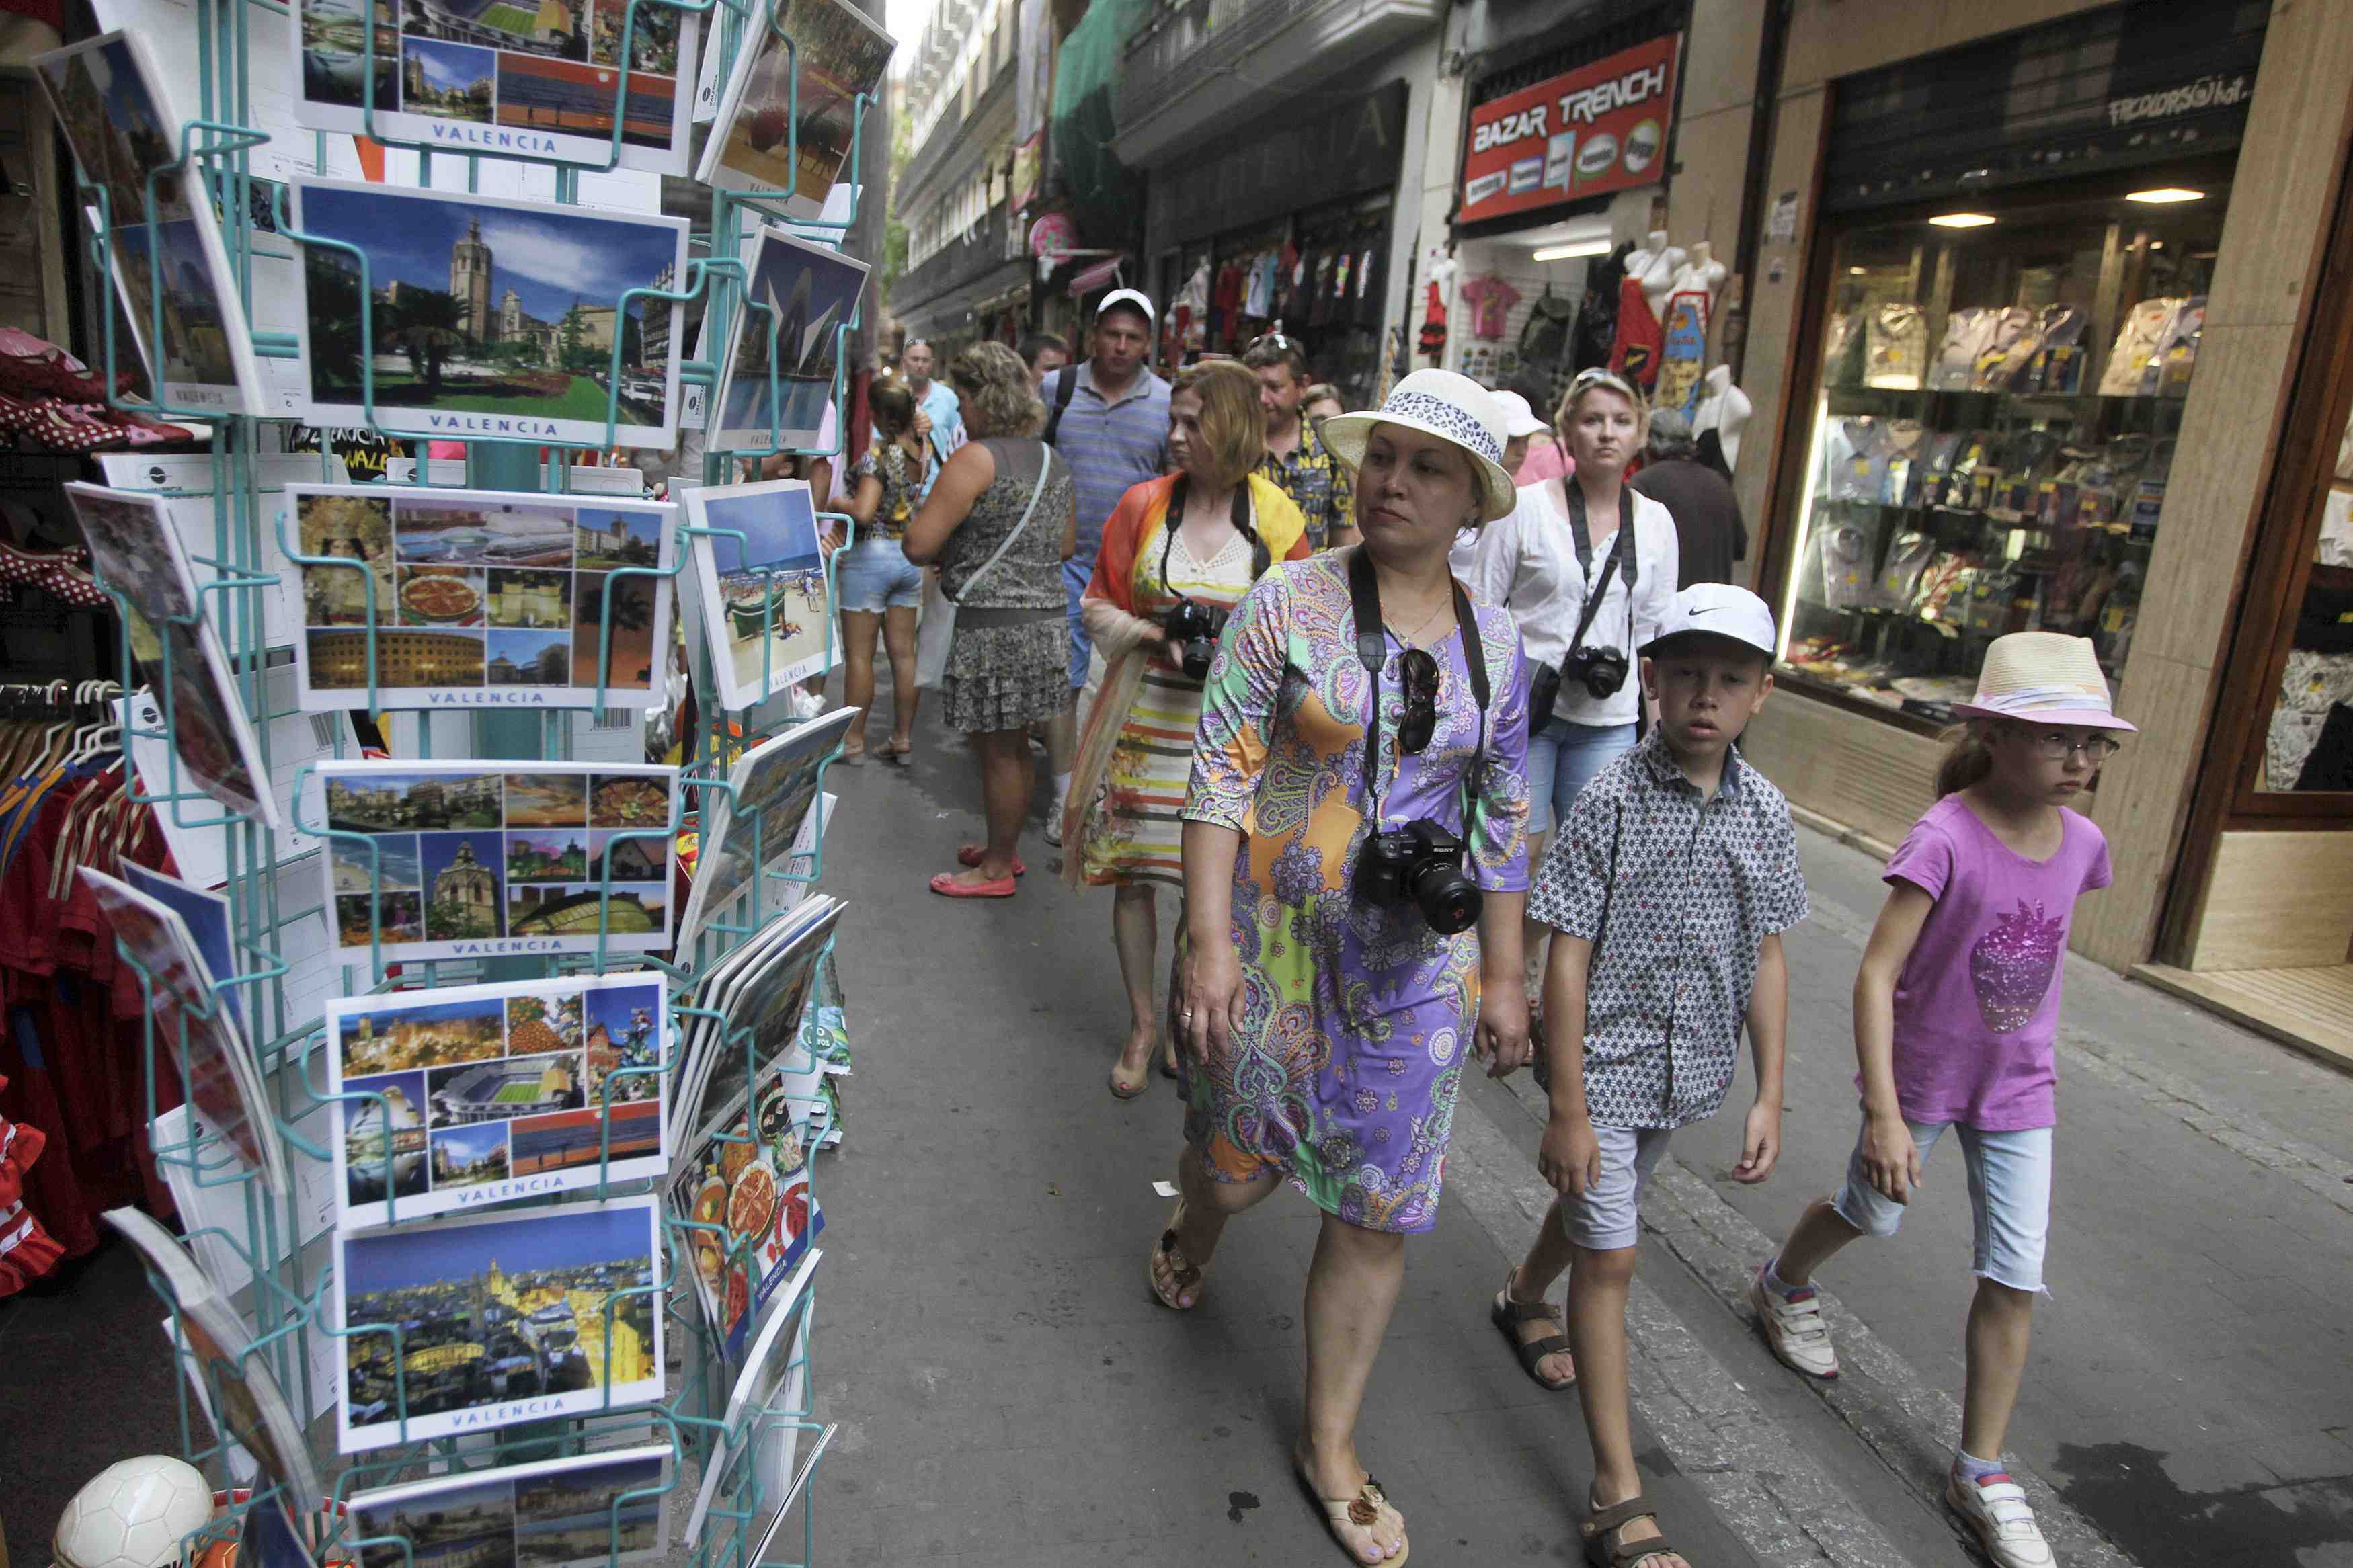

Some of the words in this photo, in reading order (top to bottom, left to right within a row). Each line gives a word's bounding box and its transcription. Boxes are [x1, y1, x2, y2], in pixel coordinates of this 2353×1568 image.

[1473, 105, 1547, 153] BAZAR
[1559, 64, 1665, 124] TRENCH
[432, 124, 557, 153] VALENCIA
[430, 415, 557, 436] VALENCIA
[429, 692, 543, 703] VALENCIA
[452, 940, 562, 954] VALENCIA
[458, 1177, 564, 1204] VALENCIA
[758, 1259, 787, 1301] VALENCIA
[452, 1399, 563, 1426] VALENCIA
